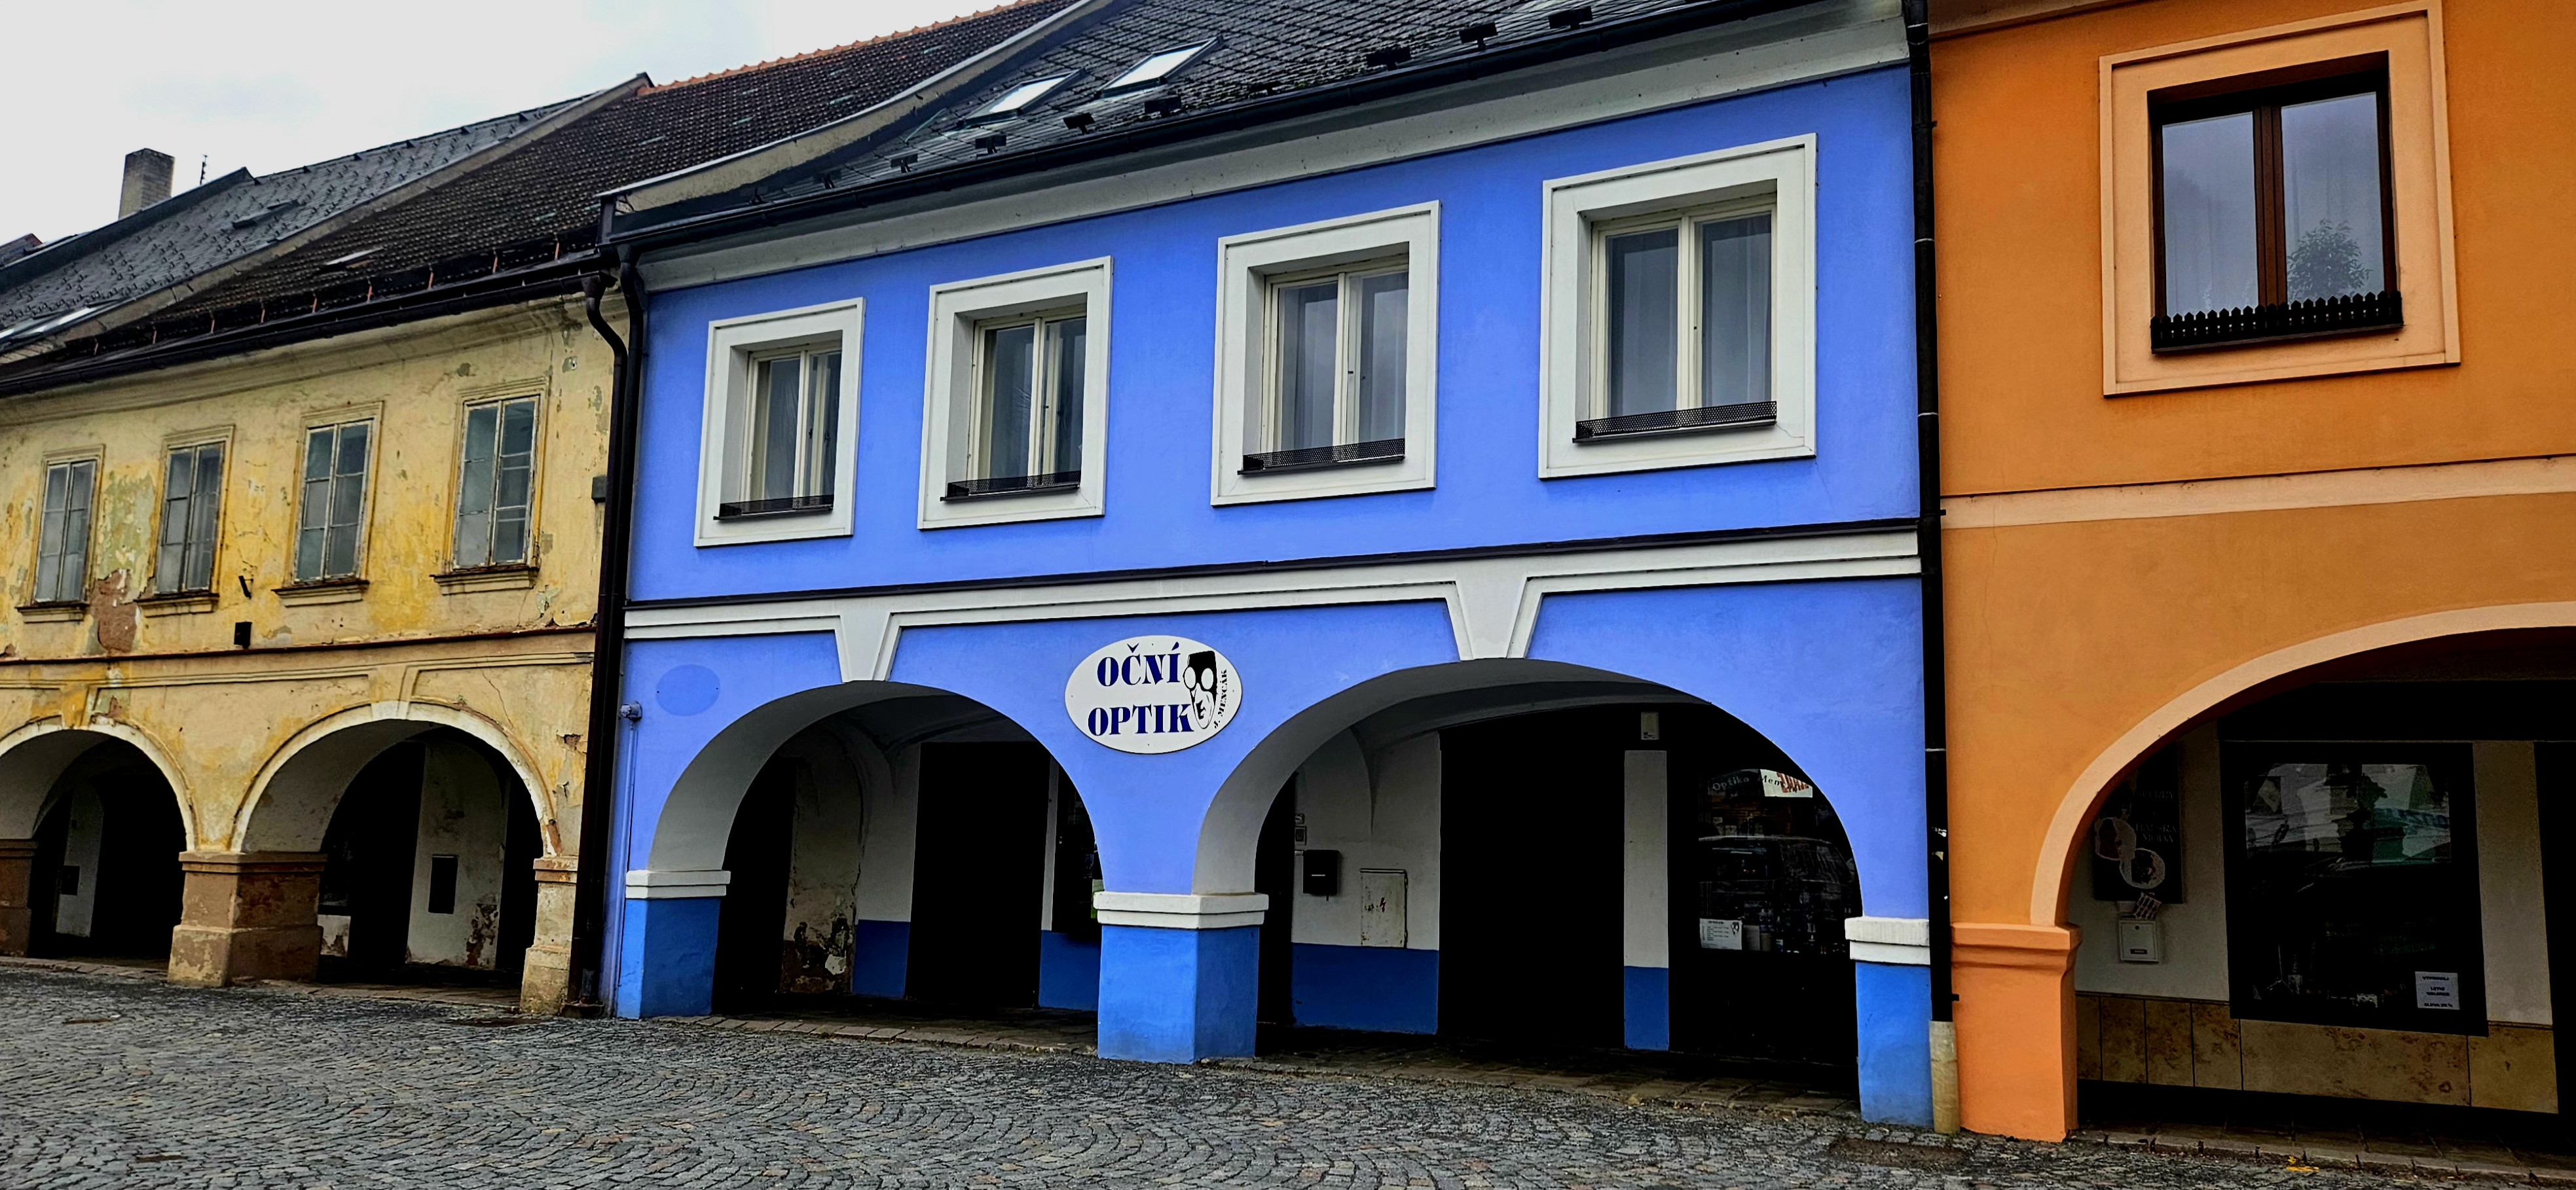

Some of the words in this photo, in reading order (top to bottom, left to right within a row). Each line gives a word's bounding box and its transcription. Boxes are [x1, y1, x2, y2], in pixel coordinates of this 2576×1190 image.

[1097, 641, 1181, 687] OČNÍ
[1088, 704, 1194, 736] OPTIK
[1712, 776, 1750, 791] Optika
